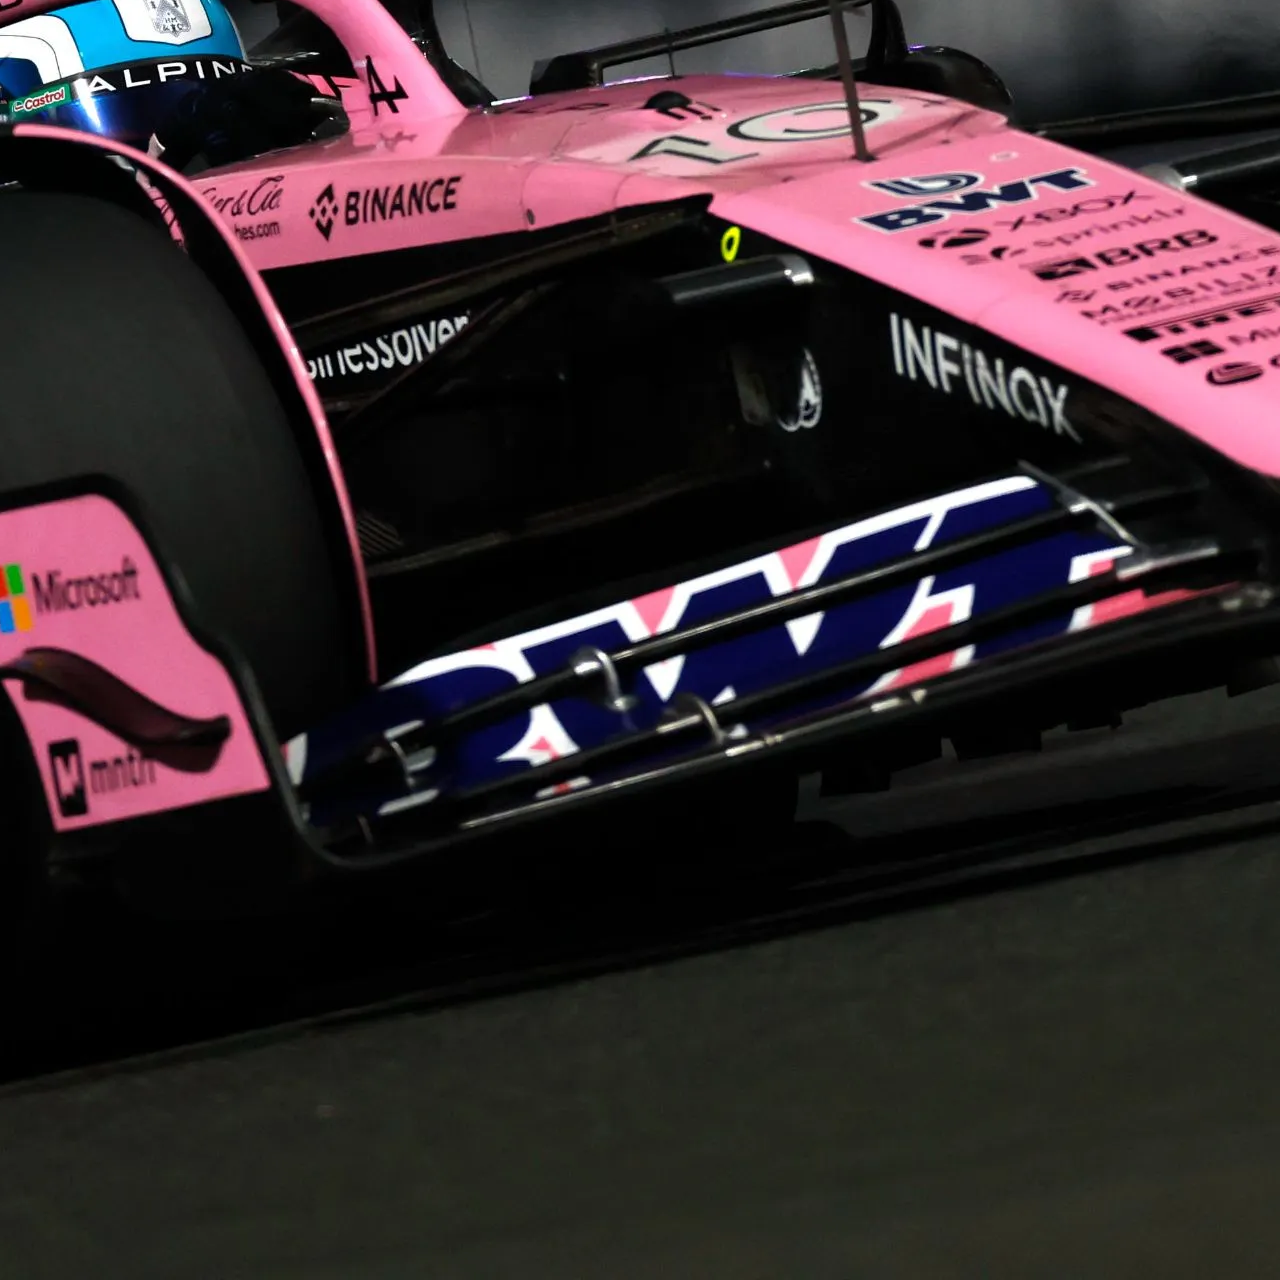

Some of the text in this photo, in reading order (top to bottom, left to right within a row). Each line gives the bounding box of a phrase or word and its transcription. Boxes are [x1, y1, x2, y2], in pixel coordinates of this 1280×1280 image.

[24, 87, 66, 112] Castrol
[344, 175, 463, 226] BINANCE
[853, 167, 1098, 234] BWT
[998, 188, 1156, 233] XBOX
[1031, 204, 1187, 249] sprinklr
[1095, 228, 1220, 268] BRB
[889, 311, 1082, 444] INFINOX
[31, 555, 142, 615] Microsoft
